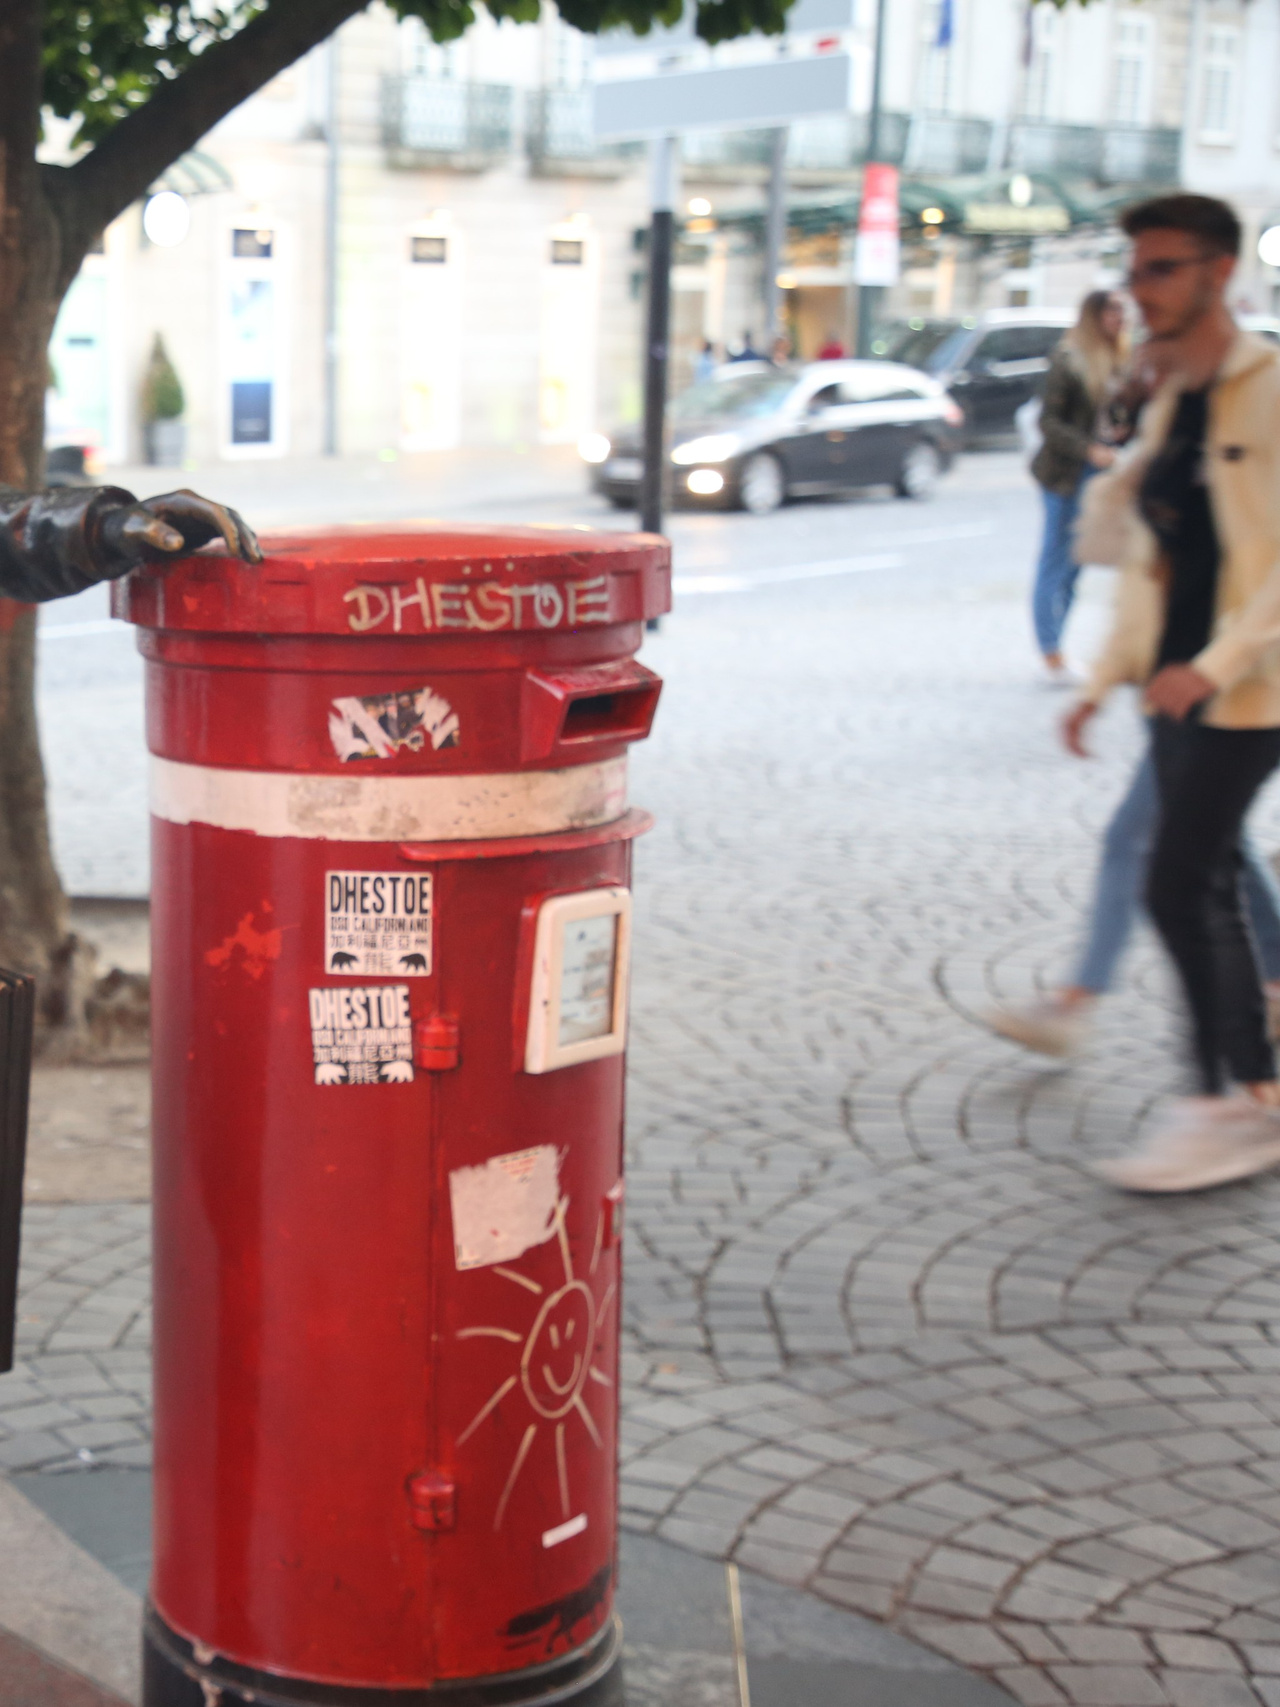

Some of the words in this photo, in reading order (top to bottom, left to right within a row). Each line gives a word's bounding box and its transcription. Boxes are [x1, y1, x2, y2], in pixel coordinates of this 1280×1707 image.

[344, 577, 611, 633] DHESTOE
[330, 875, 429, 915] DHESTOE
[309, 985, 411, 1030] DHESTOE
